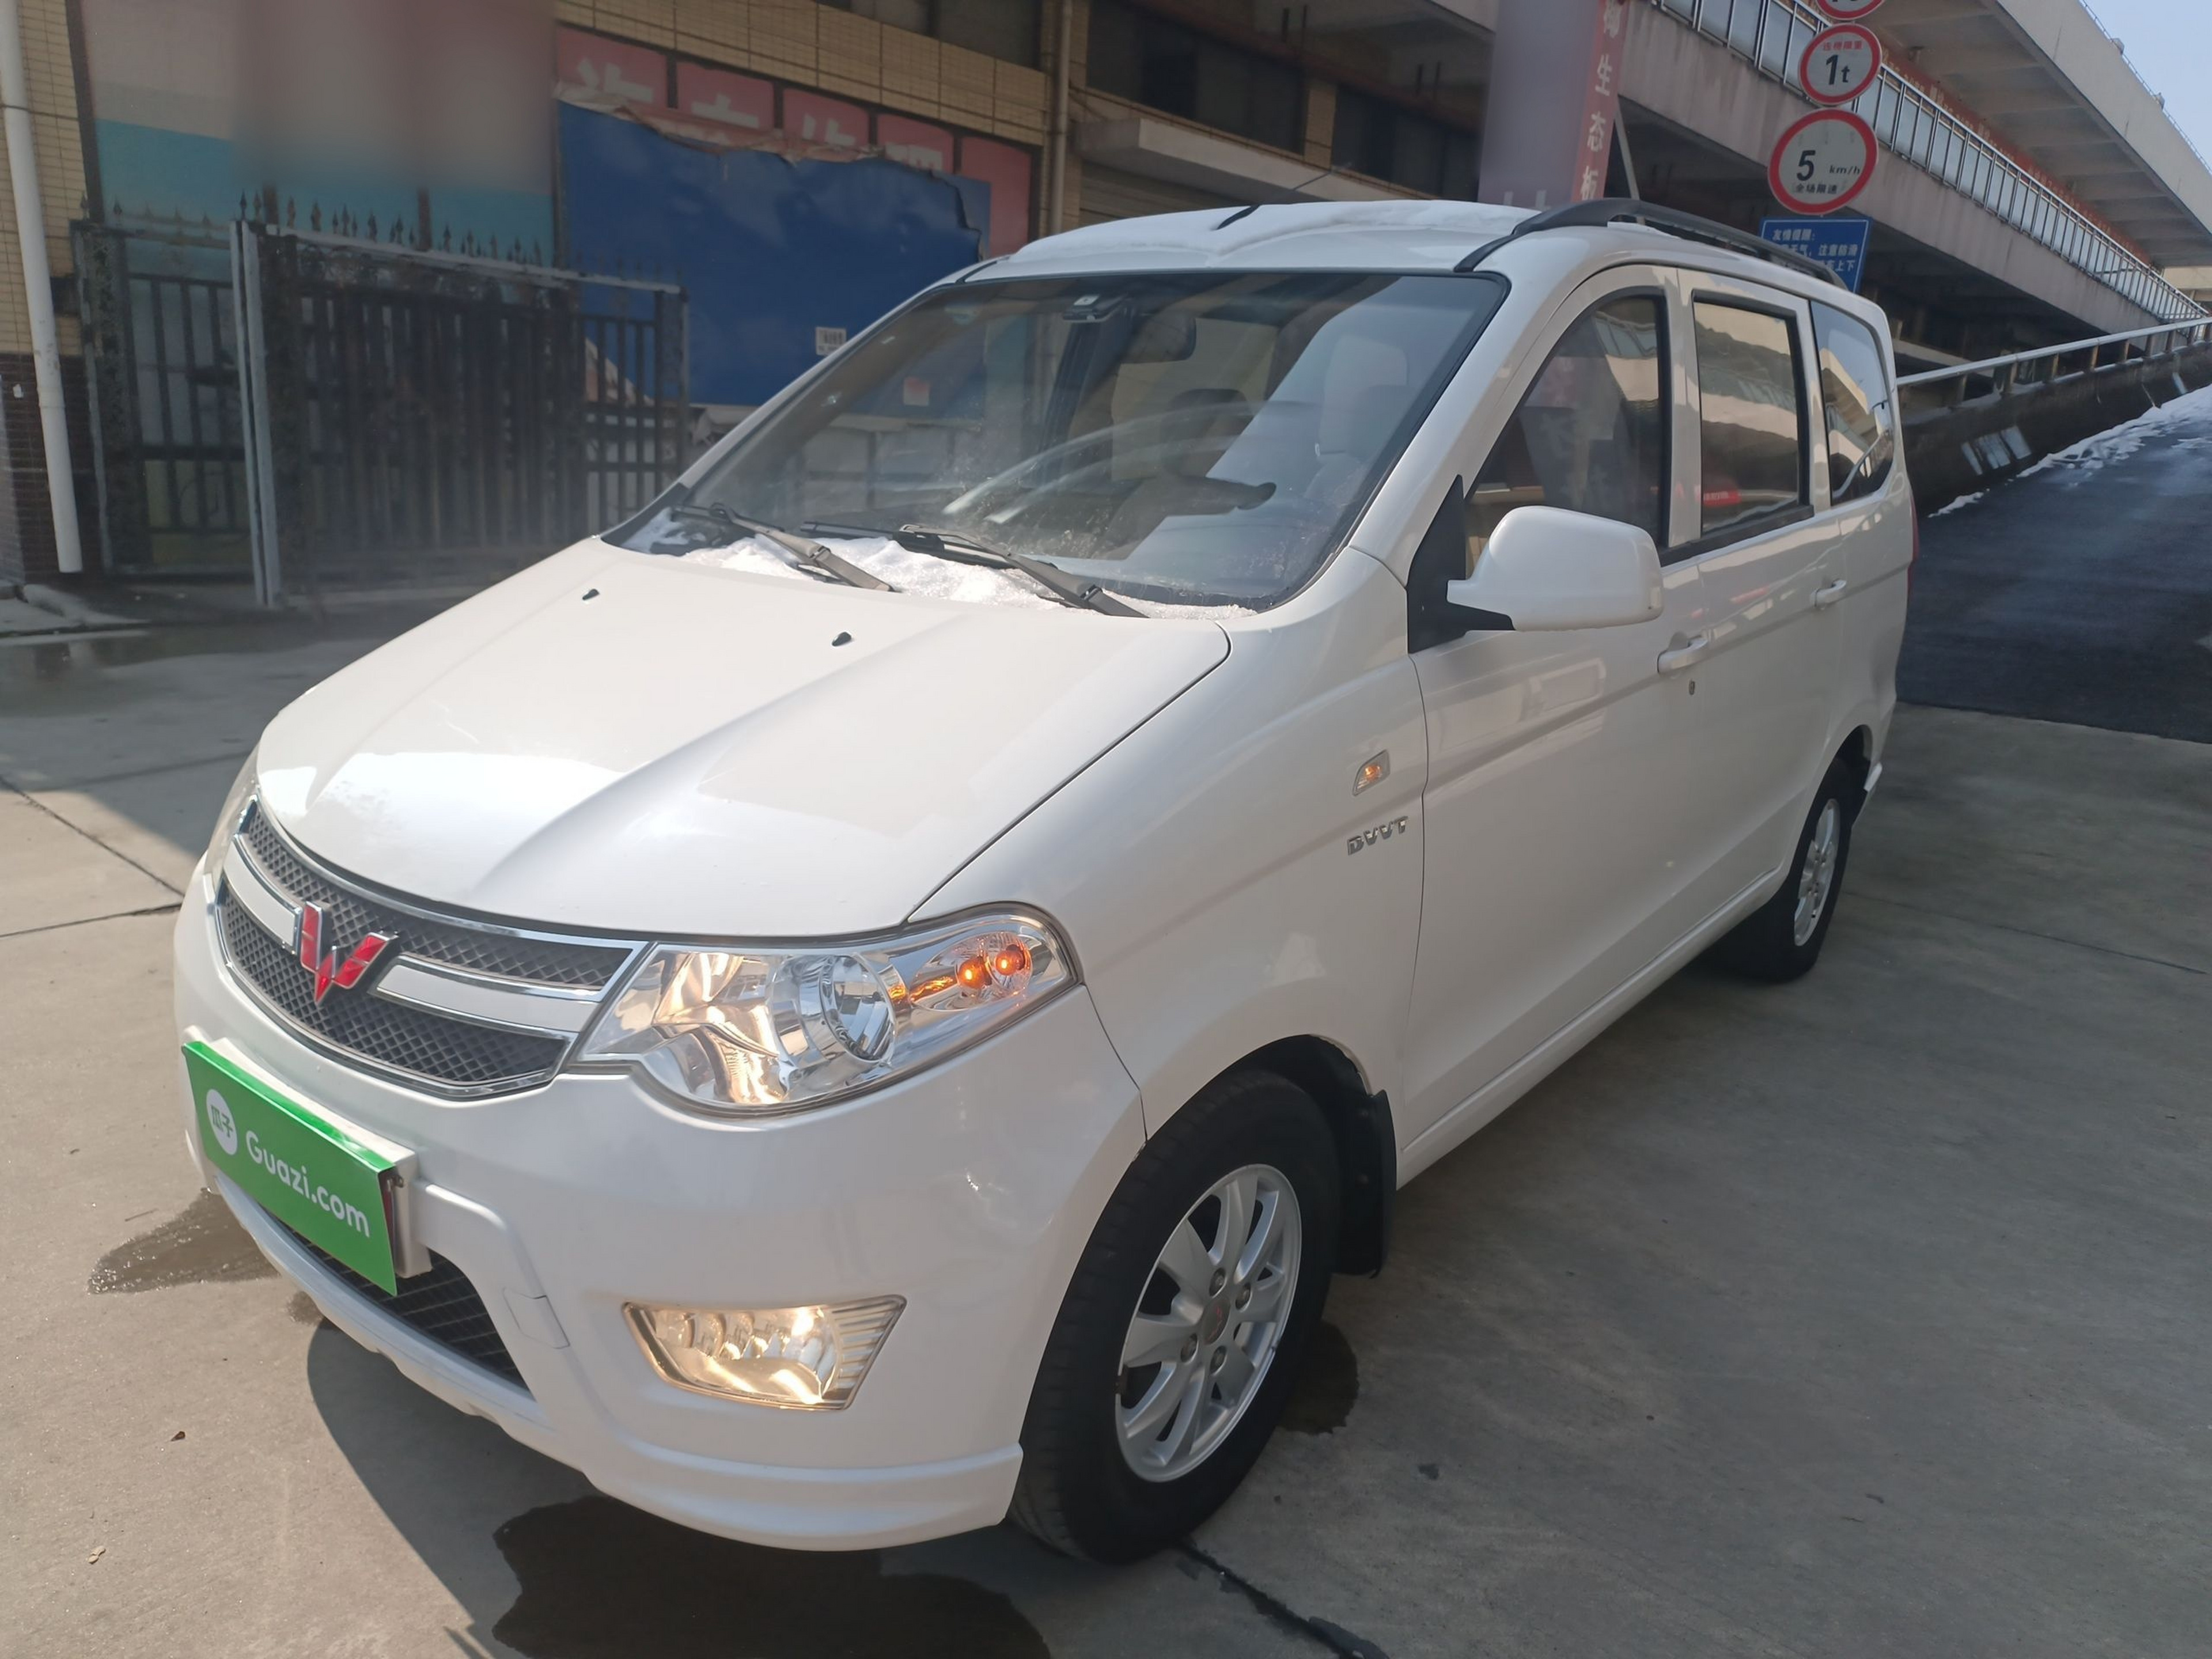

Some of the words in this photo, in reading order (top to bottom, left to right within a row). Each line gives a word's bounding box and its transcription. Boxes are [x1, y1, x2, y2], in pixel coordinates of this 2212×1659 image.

[1797, 150, 1816, 181] 5
[1829, 165, 1861, 175] km/h
[1347, 816, 1409, 856] DVVT
[245, 1130, 370, 1238] Guazi.com
